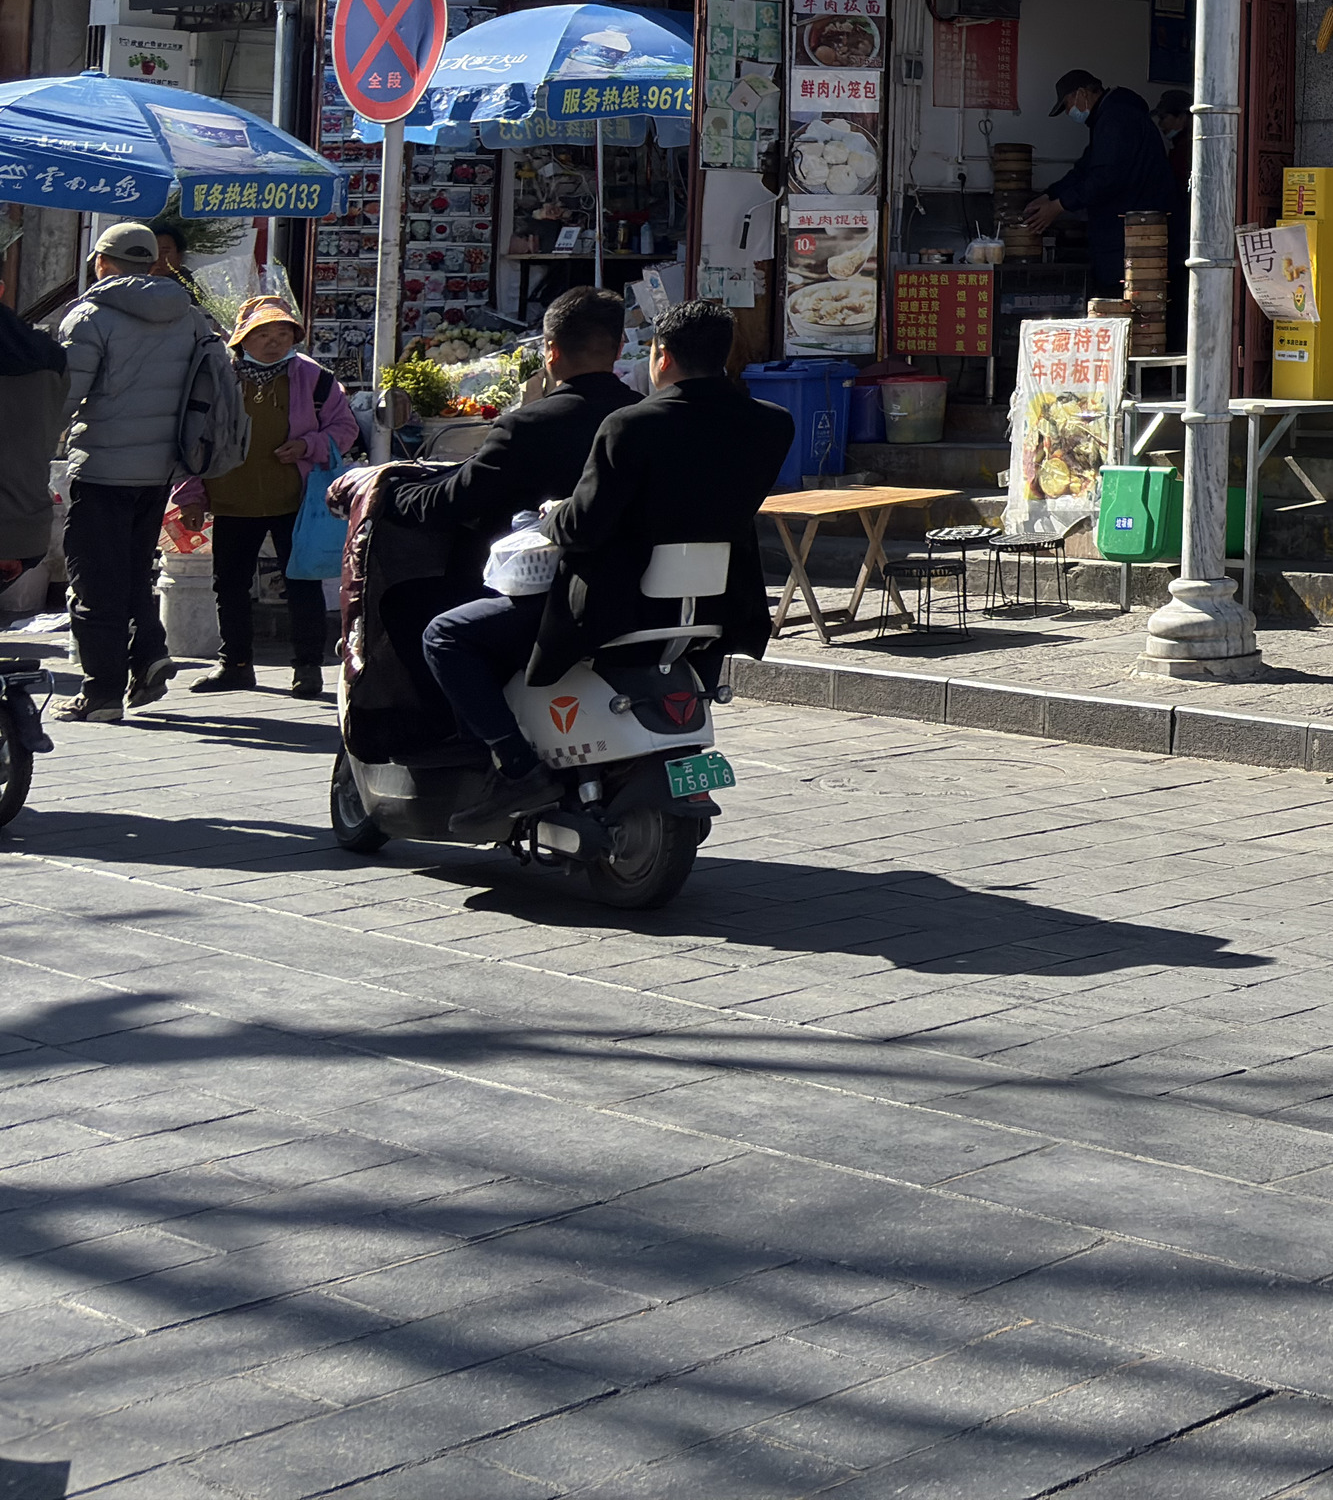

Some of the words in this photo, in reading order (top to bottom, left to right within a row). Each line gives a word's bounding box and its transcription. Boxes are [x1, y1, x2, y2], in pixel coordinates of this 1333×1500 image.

[368, 71, 402, 89] 全段
[801, 80, 876, 99] 鲜肉小笼包
[193, 182, 321, 212] 服务热线:96133
[797, 215, 869, 226] 鲜肉馄饨
[1240, 232, 1277, 275] 聘
[898, 273, 949, 286] 鲜肉小笼包
[897, 313, 938, 325] 手工水饺
[1032, 327, 1113, 355] 安徽特色
[1030, 358, 1112, 385] 牛肉板面
[706, 758, 719, 768] L
[674, 768, 732, 793] 75818
